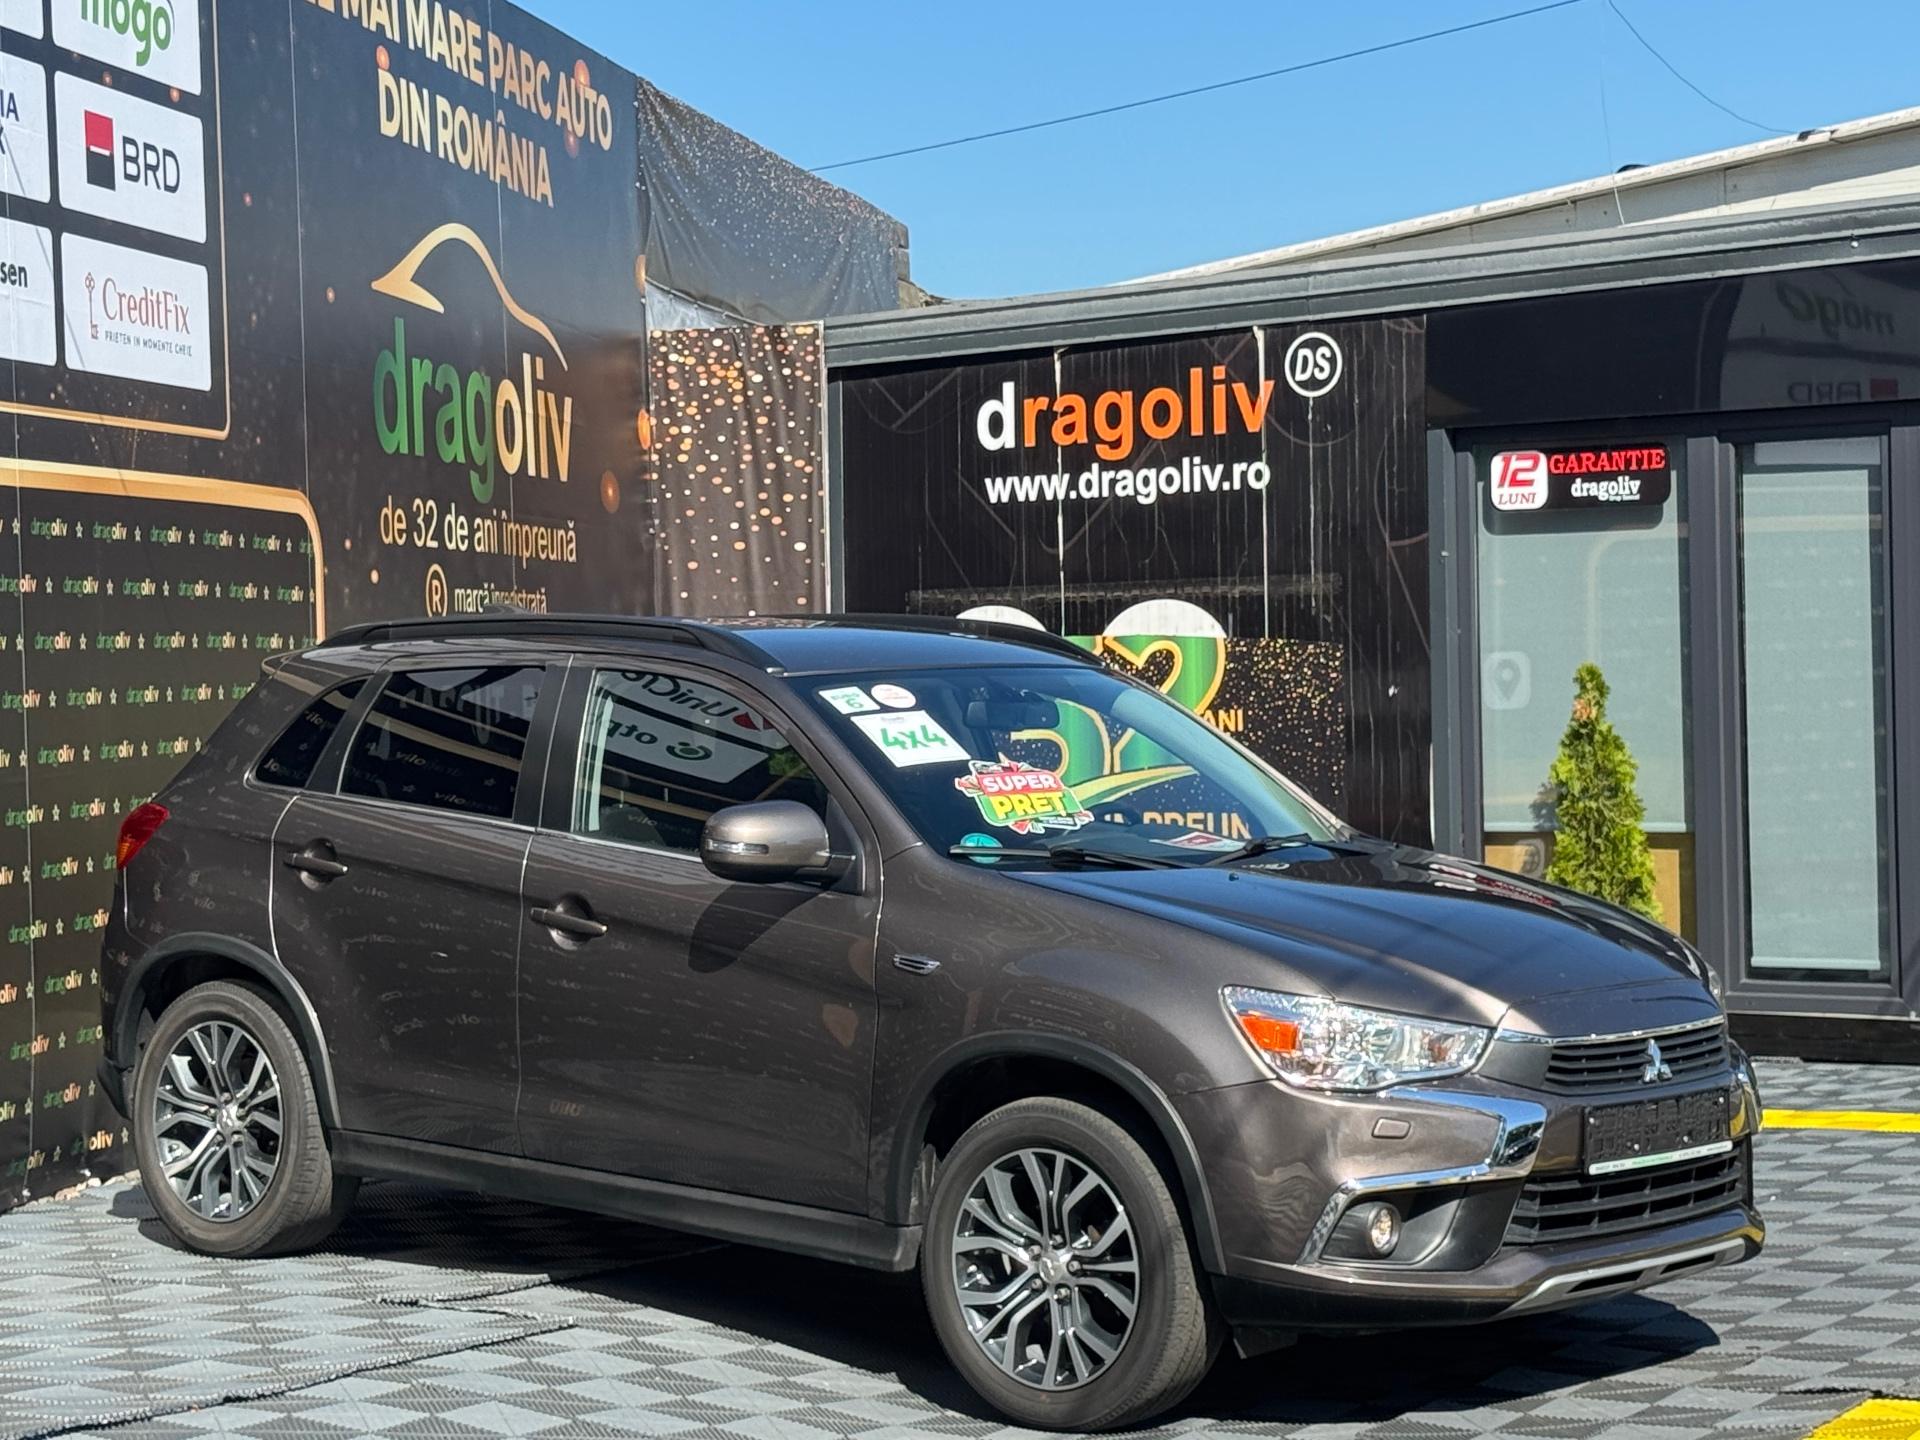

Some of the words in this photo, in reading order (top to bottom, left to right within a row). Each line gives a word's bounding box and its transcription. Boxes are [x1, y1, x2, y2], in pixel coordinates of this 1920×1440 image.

[406, 0, 485, 87] MARE
[488, 31, 552, 120] PARC
[556, 71, 612, 151] AUTO
[378, 68, 431, 154] DIN
[435, 94, 554, 208] ROMÂNIA
[123, 136, 181, 194] BRD
[102, 277, 190, 335] CreditFix
[1294, 347, 1333, 382] DS
[373, 316, 573, 505] dragoliv
[976, 365, 1275, 460] dragoliv
[984, 456, 1271, 504] www.dragoliv.ro
[1497, 453, 1541, 489] 12
[1550, 449, 1666, 474] GARANTIE
[1570, 475, 1641, 501] dragoliv
[1498, 493, 1537, 506] LUNI
[380, 495, 407, 546] de
[412, 498, 439, 549] 32
[444, 502, 469, 551] de
[474, 510, 498, 554] ani
[501, 510, 577, 570] împreună
[983, 774, 1058, 793] SUPER
